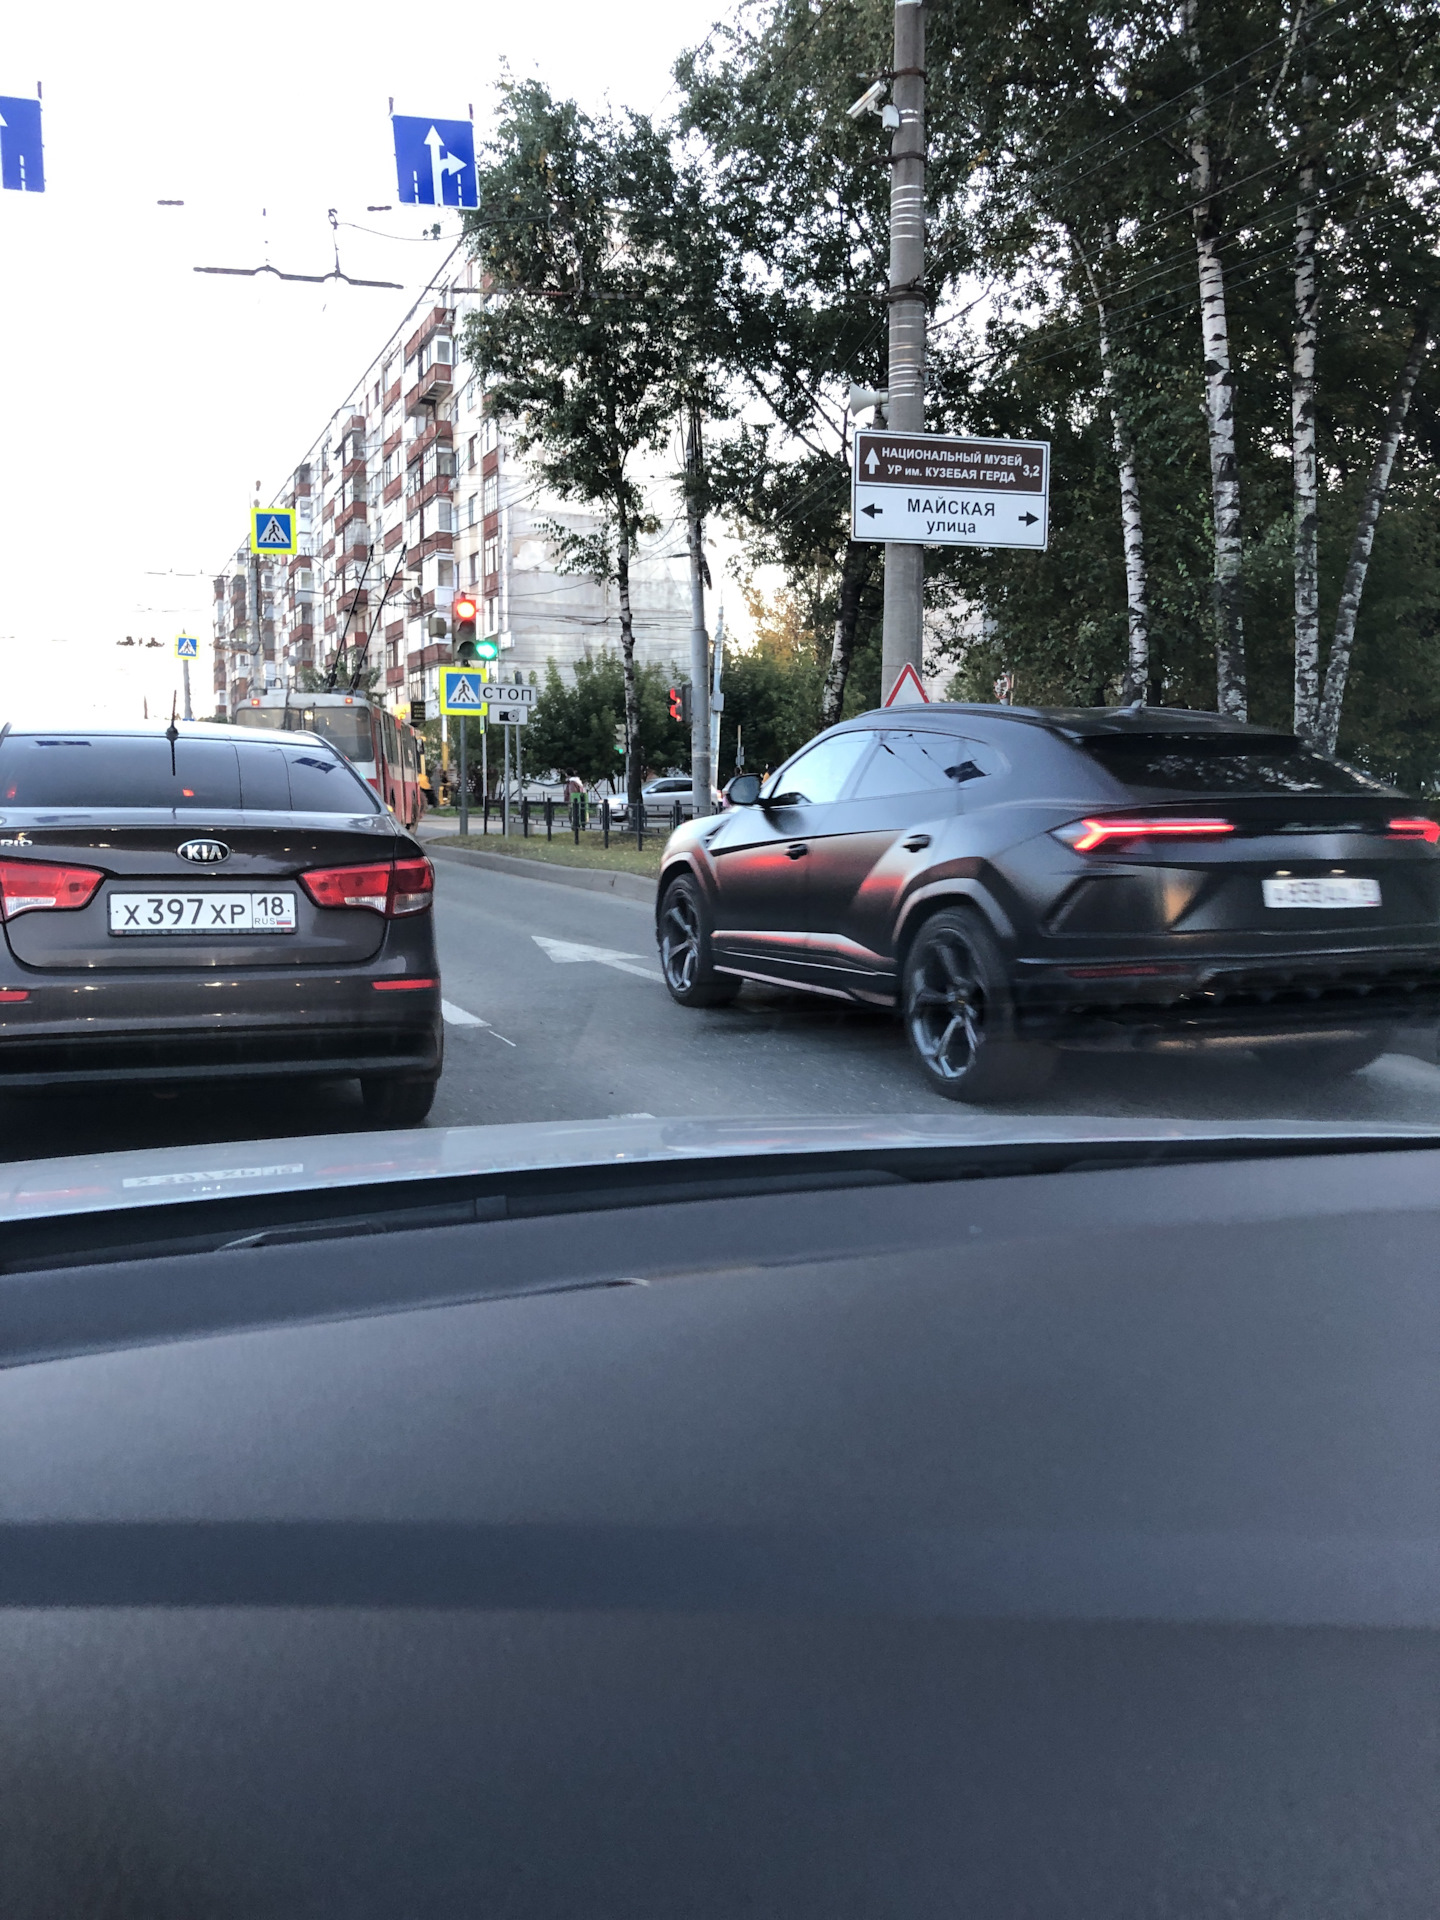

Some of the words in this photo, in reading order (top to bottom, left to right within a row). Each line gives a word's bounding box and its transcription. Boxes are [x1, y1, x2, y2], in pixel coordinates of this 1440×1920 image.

[881, 446, 982, 464] НАЦИОНАЛЬНЫЙ
[984, 454, 1022, 467] МУЗЕЙ
[887, 464, 902, 475] УР
[904, 468, 922, 477] им.
[925, 466, 977, 480] КУЗЕБАЯ
[979, 470, 1016, 483] ГЕРДА
[1022, 465, 1040, 479] 3,2
[907, 496, 995, 517] МАЙСКАЯ
[926, 520, 976, 535] улица
[482, 687, 532, 701] СТОП
[0, 839, 33, 847] RIO
[186, 844, 223, 860] KIA
[257, 896, 284, 916] 18
[254, 917, 276, 925] RUS
